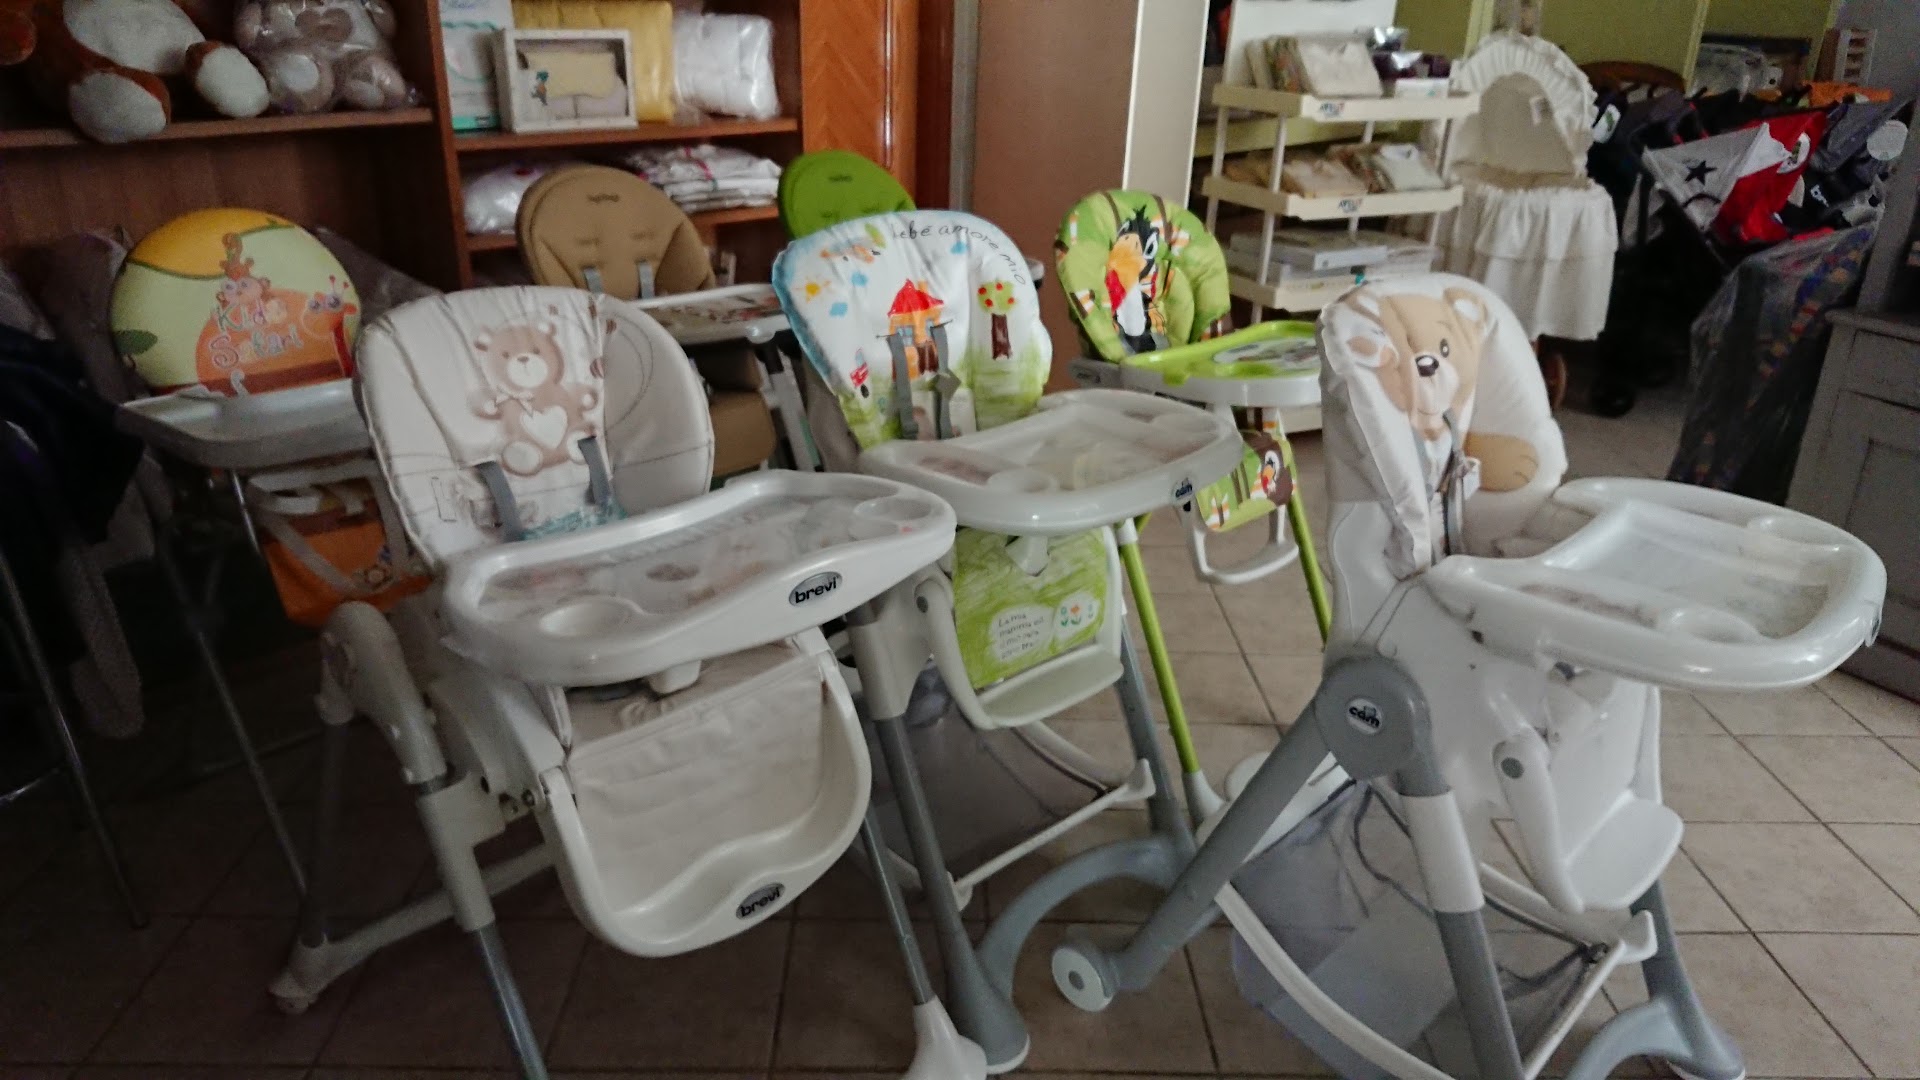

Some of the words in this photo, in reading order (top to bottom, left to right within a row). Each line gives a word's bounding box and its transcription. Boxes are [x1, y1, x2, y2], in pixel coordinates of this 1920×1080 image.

[938, 225, 999, 249] amore
[999, 253, 1026, 286] mio
[216, 297, 288, 333] Kid
[209, 324, 304, 370] Sfari
[794, 576, 838, 604] brevi
